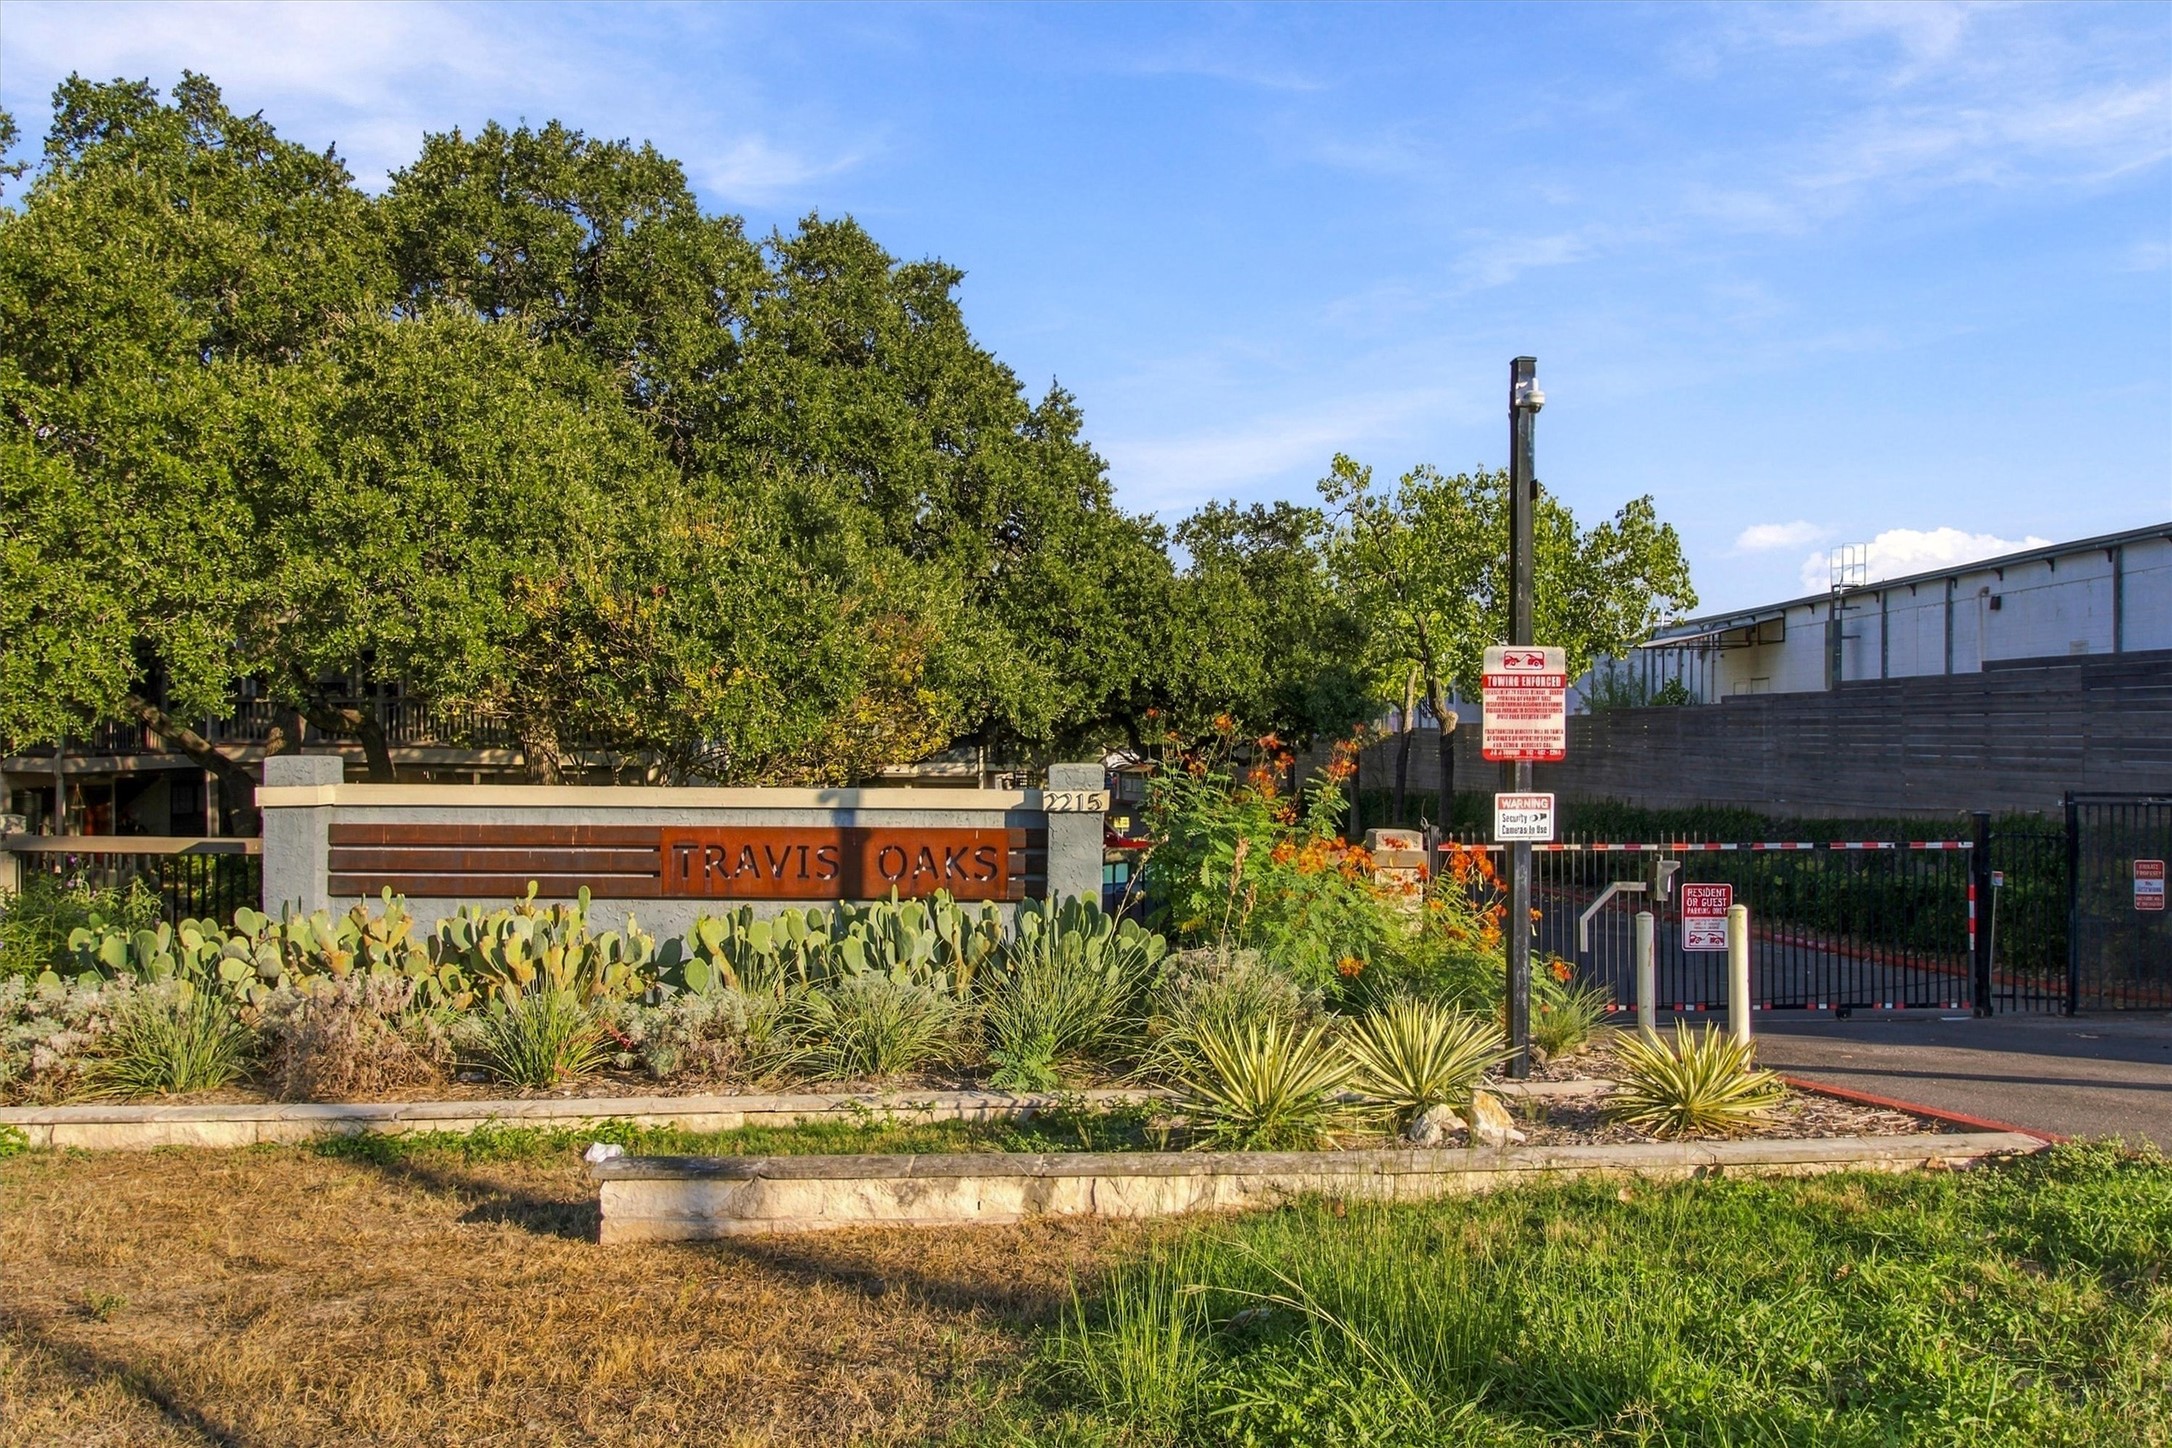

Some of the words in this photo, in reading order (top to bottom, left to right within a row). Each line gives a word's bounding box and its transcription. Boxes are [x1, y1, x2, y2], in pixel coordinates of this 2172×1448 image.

[1487, 675, 1519, 687] TOWING
[1521, 675, 1561, 687] ENFORCED
[1044, 793, 1103, 811] 2215
[1501, 798, 1549, 809] WARNING
[1502, 813, 1527, 824] Security
[1502, 825, 1528, 834] Cameras
[672, 844, 840, 881] TRAVIS
[878, 845, 998, 882] OAKS
[1687, 888, 1726, 897] RESIDENT
[1686, 898, 1698, 907] OR
[1701, 898, 1726, 907] GUEST
[1712, 907, 1726, 915] ONLY
